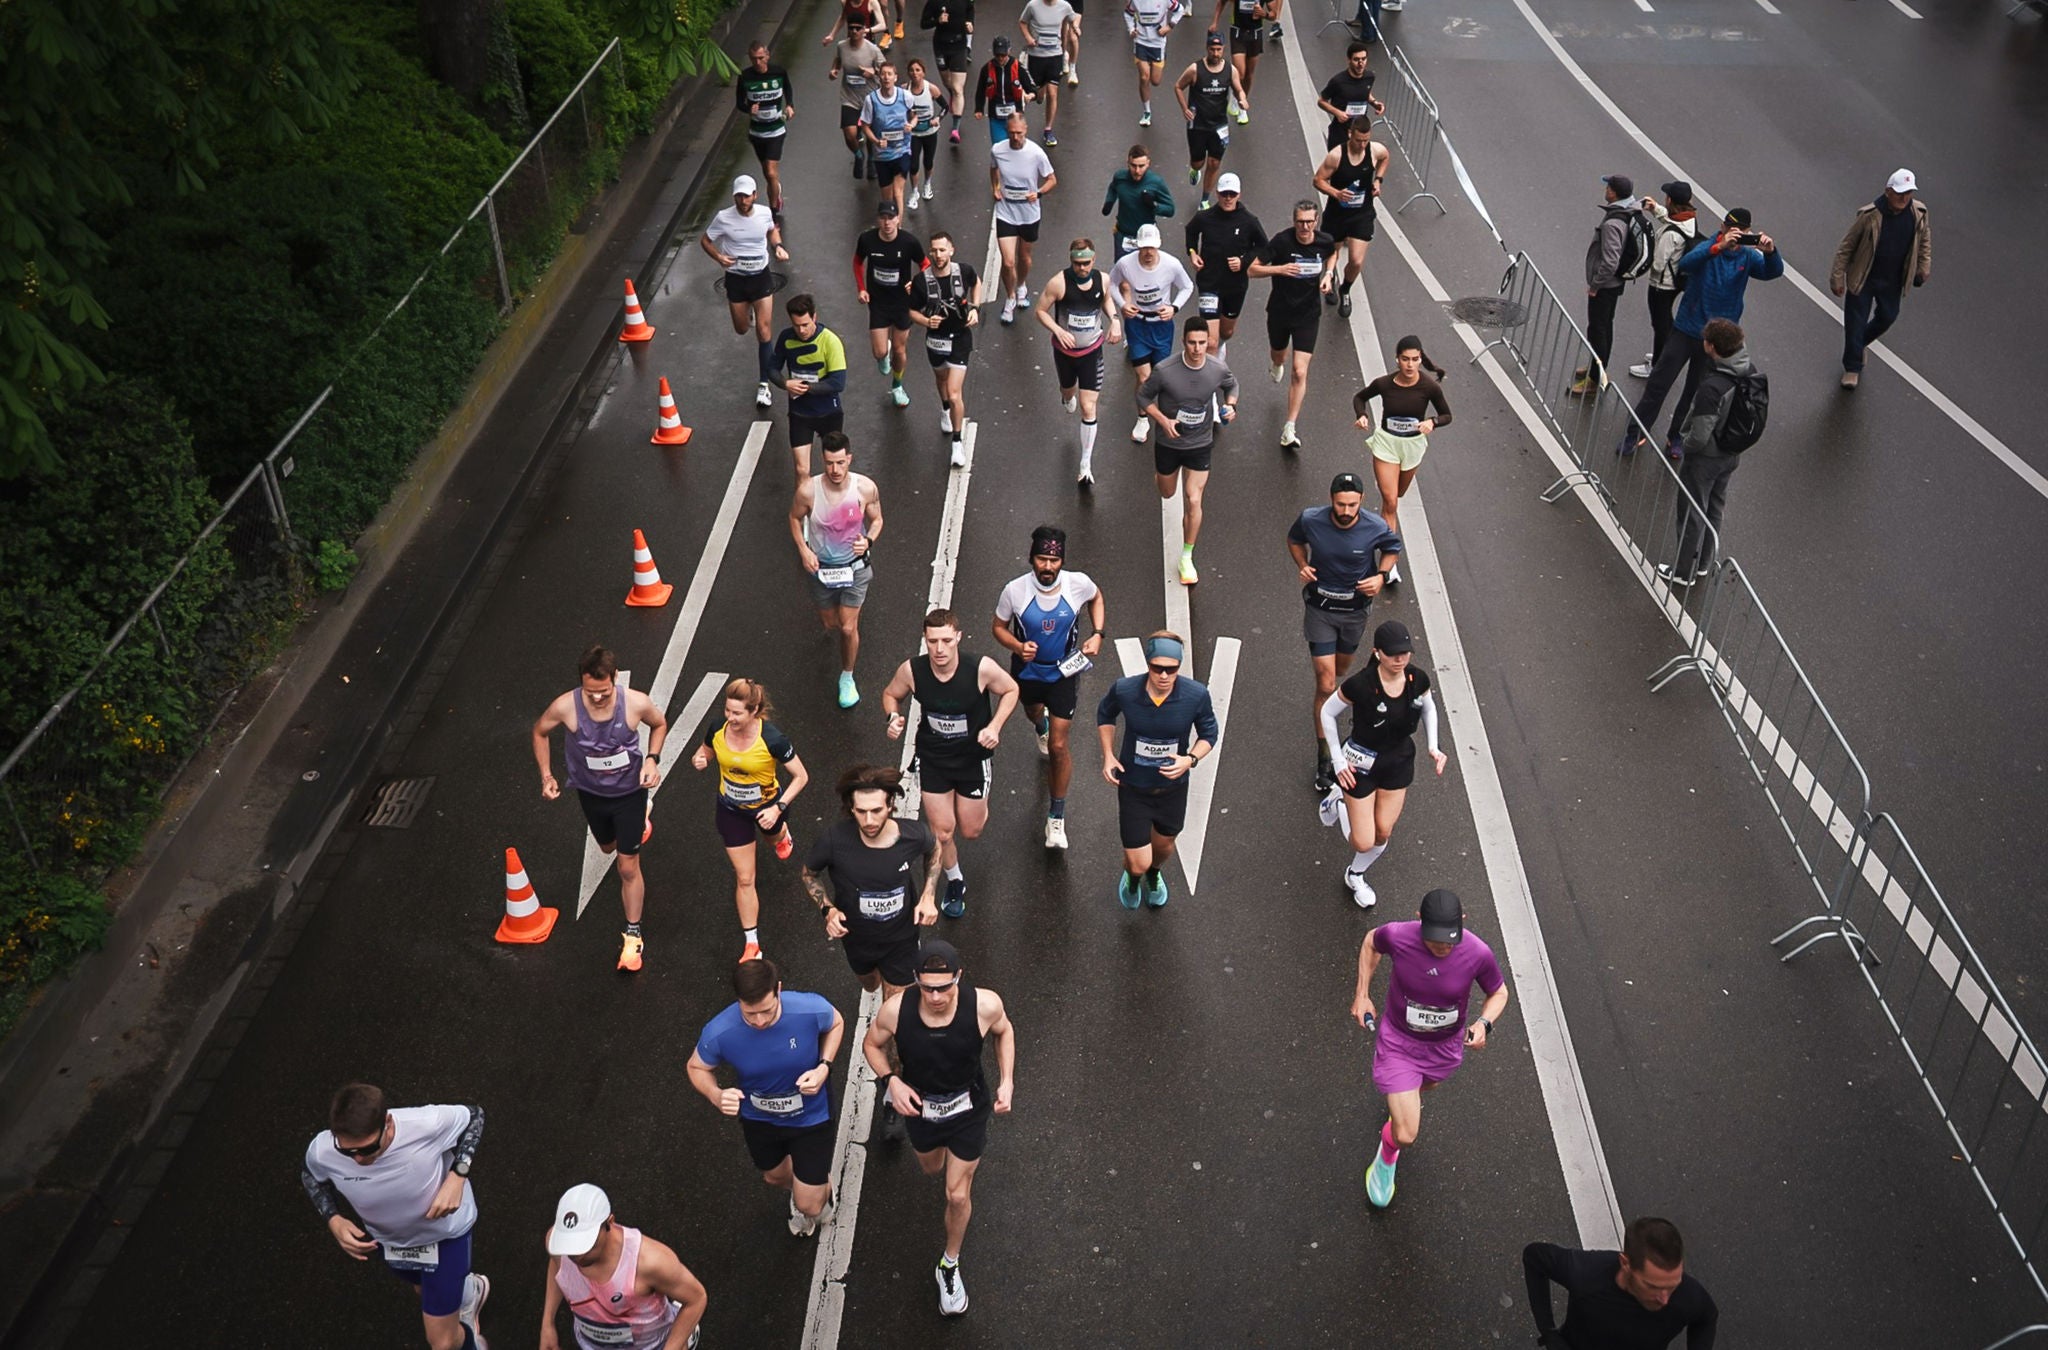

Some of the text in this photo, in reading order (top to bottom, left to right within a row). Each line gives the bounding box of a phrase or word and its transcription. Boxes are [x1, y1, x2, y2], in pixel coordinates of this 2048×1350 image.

[1345, 749, 1363, 762] NINA
[867, 899, 897, 908] LUKAS
[1418, 1012, 1446, 1021] RETO
[760, 1099, 792, 1107] COLIN
